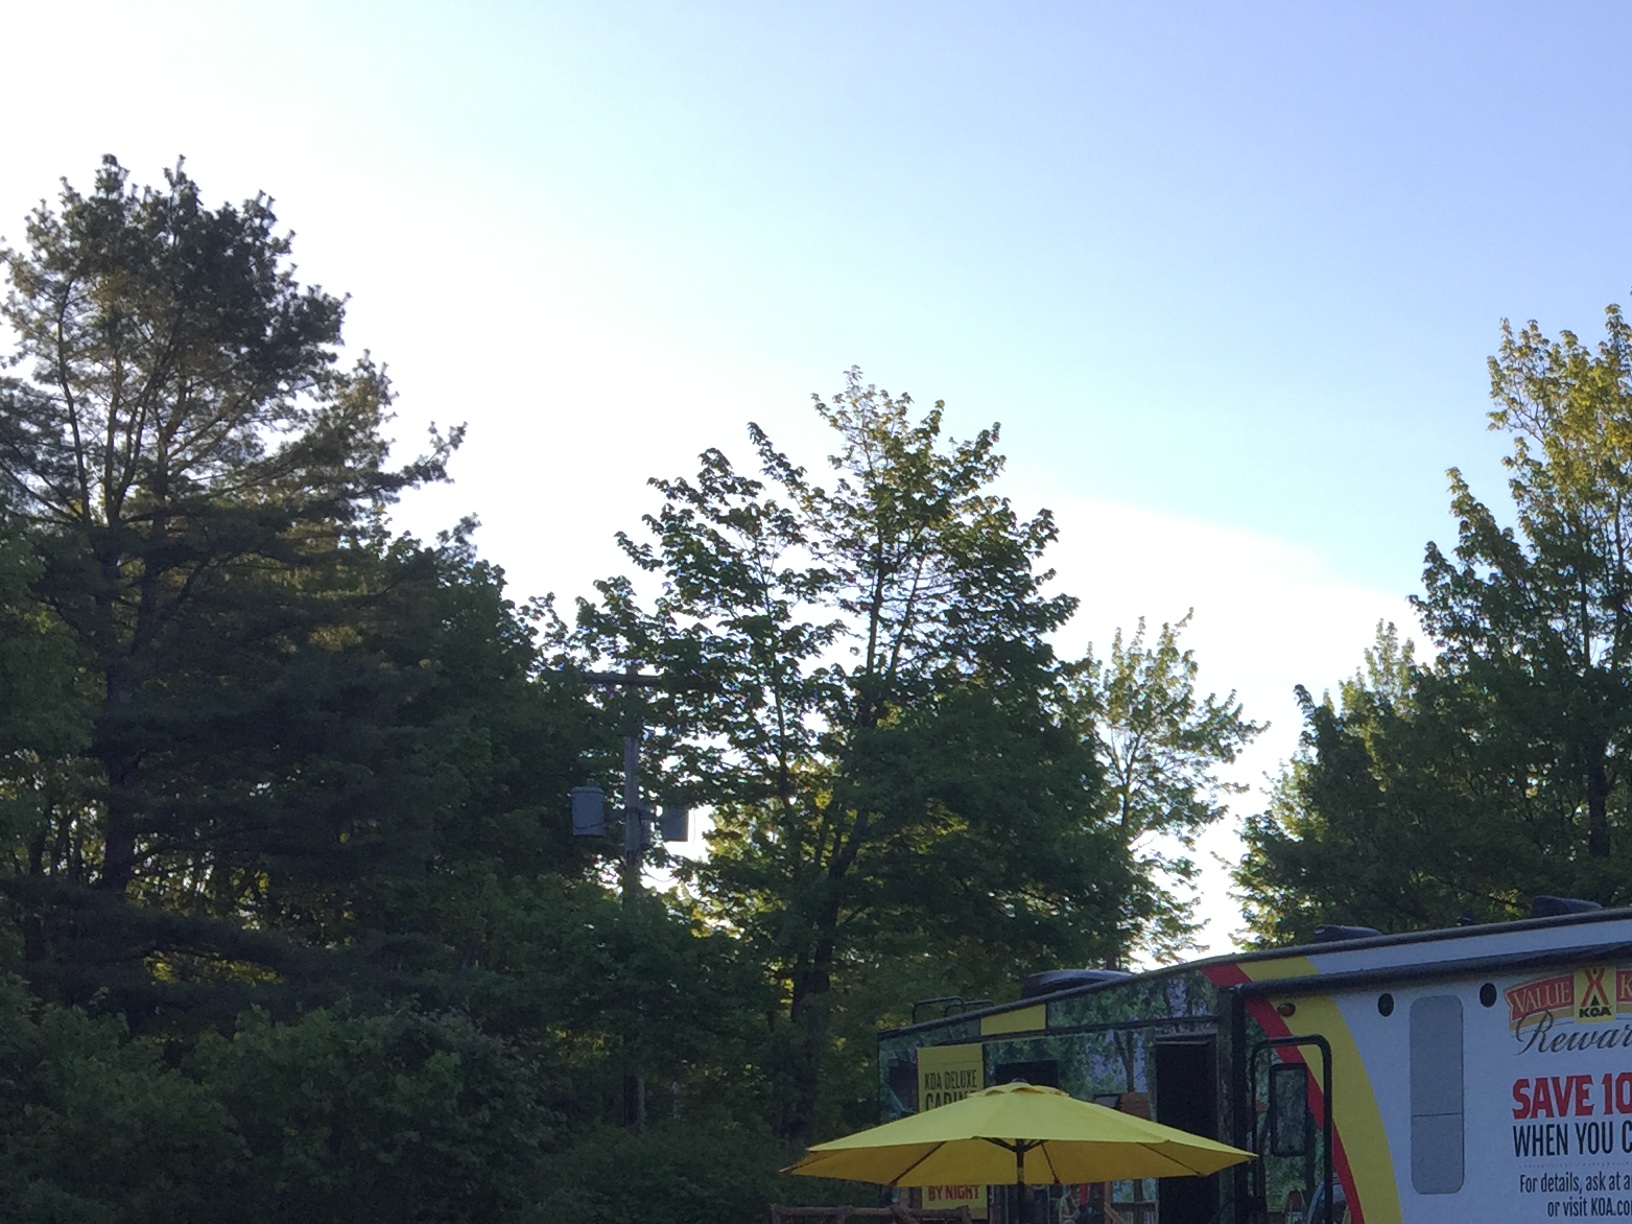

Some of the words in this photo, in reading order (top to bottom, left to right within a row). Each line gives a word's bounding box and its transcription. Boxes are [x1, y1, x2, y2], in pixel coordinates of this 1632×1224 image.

[1513, 980, 1572, 1014] VALUE
[1579, 1007, 1612, 1018] KOA
[925, 1072, 942, 1089] KOA
[944, 1069, 977, 1089] DELUXE
[1512, 1075, 1595, 1119] SAVE
[1513, 1123, 1568, 1157] WHEN
[1575, 1121, 1613, 1155] YOU
[928, 1184, 943, 1201] BY
[945, 1184, 979, 1200] NIGHT
[1519, 1174, 1538, 1193] For
[1541, 1172, 1582, 1194] details,
[1586, 1171, 1606, 1191] ask
[1609, 1171, 1620, 1191] at
[1547, 1201, 1560, 1217] or
[1563, 1196, 1587, 1217] visit
